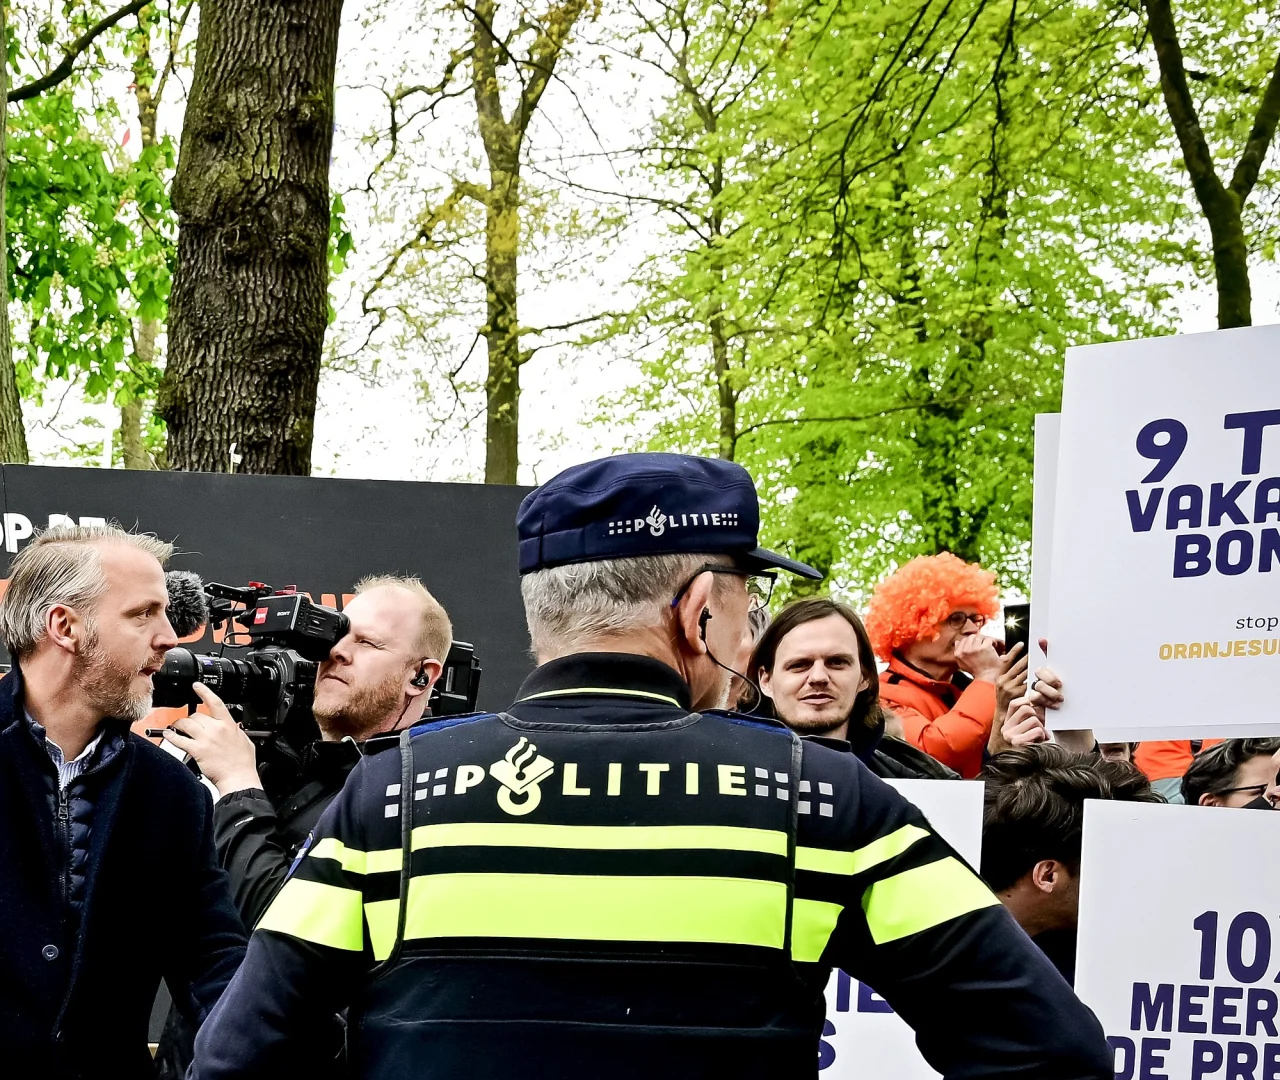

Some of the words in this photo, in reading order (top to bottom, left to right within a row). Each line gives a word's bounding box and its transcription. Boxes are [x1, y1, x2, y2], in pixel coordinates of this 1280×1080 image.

[1134, 418, 1190, 484] 9
[634, 507, 721, 536] POLITIE
[1158, 638, 1280, 661] ORANJESU
[1235, 616, 1279, 632] stop
[454, 747, 748, 807] POLITIE
[1192, 910, 1280, 984] 10
[1129, 981, 1280, 1038] MEER
